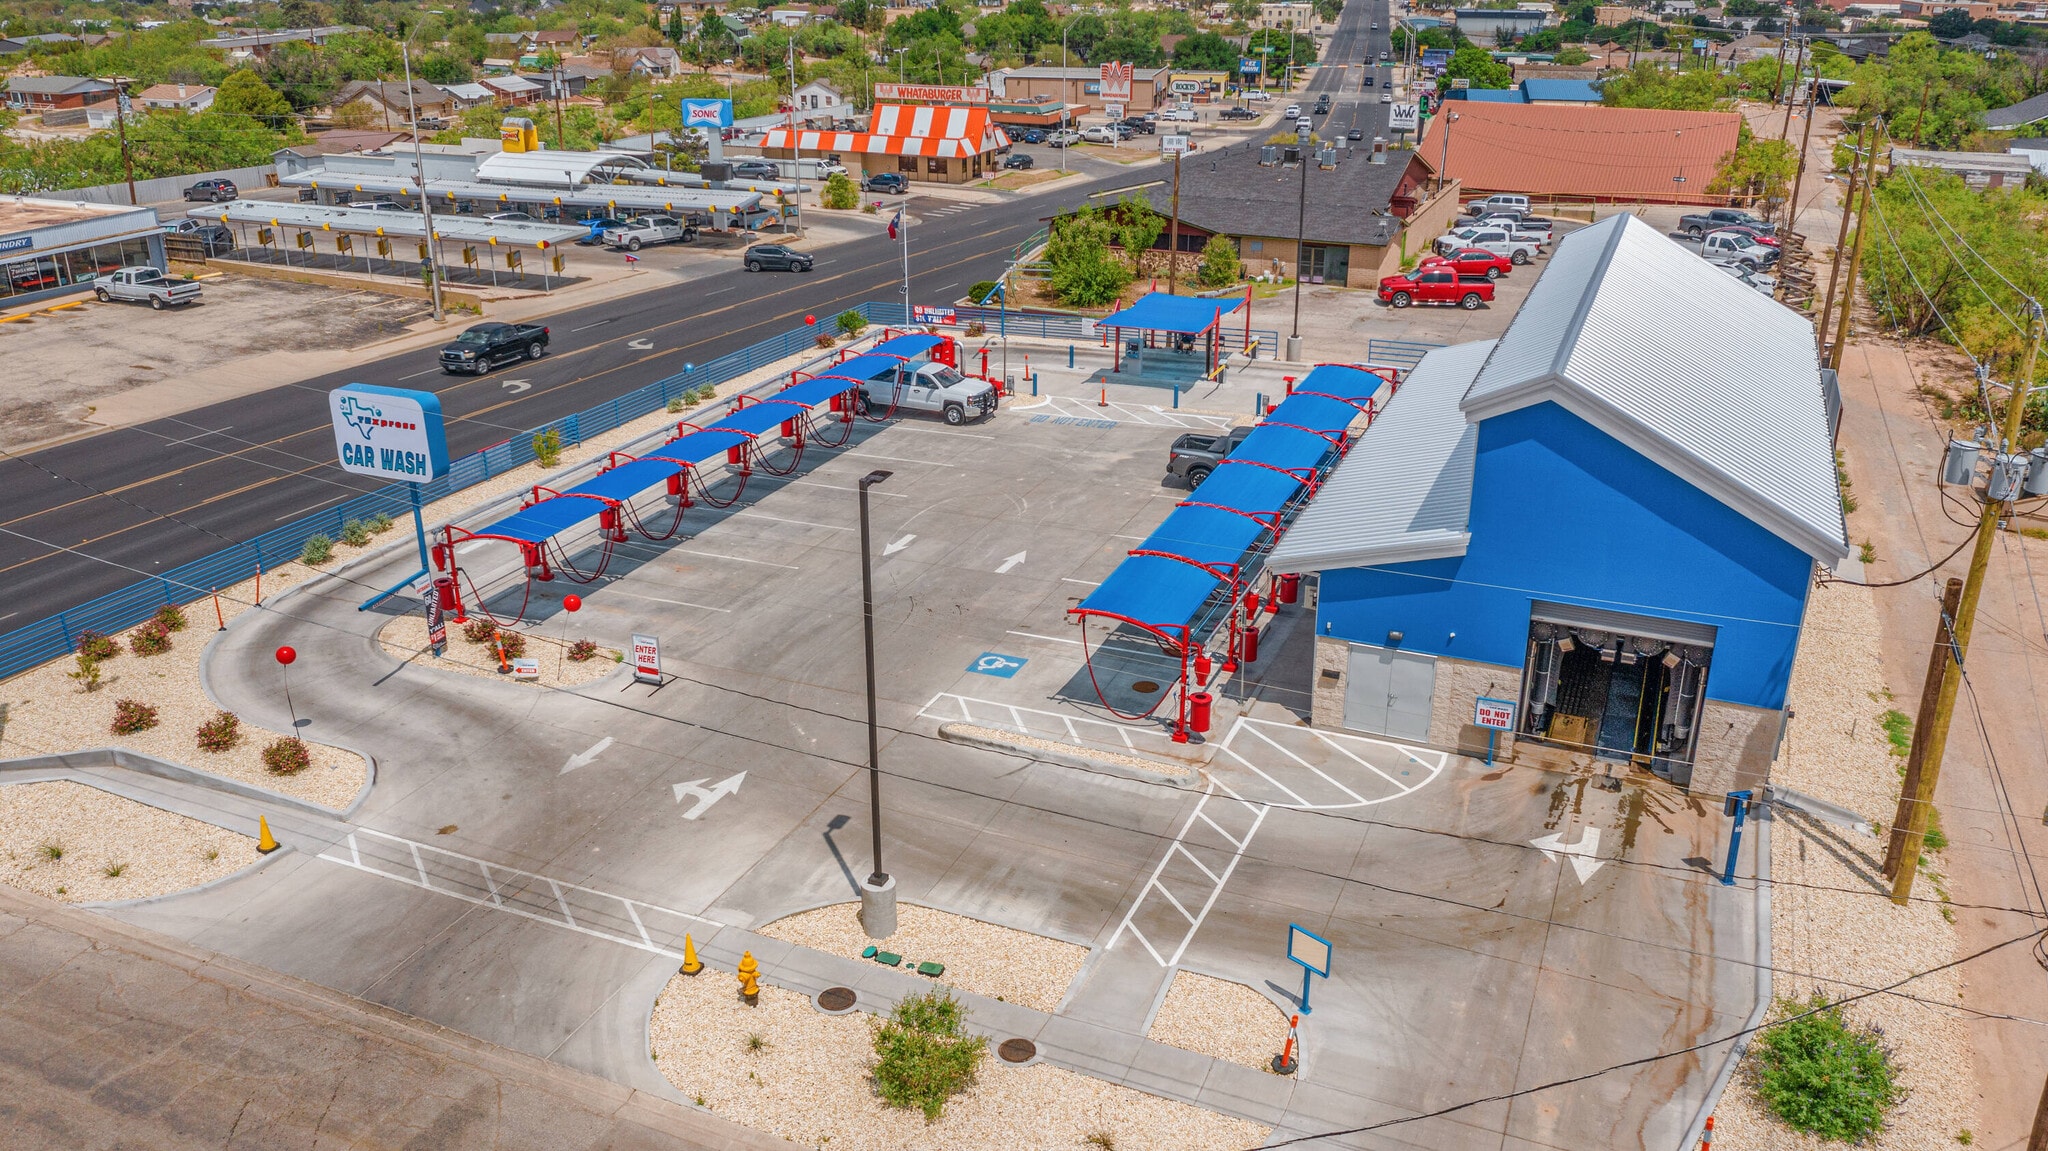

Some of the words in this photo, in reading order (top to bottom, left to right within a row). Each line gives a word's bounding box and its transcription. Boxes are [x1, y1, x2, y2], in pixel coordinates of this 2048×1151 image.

[1175, 82, 1196, 91] ROCKYS
[897, 87, 963, 100] WHATABURGER
[692, 110, 717, 118] SONIC
[1052, 416, 1078, 424] NOT
[1076, 418, 1118, 428] ENTER
[343, 442, 375, 468] CAR
[380, 447, 426, 476] WASH
[428, 590, 439, 627] UNLIMITED
[635, 644, 657, 655] ENTER
[638, 654, 656, 664] HERE
[1494, 711, 1511, 720] NOT
[1482, 718, 1506, 726] ENTER
